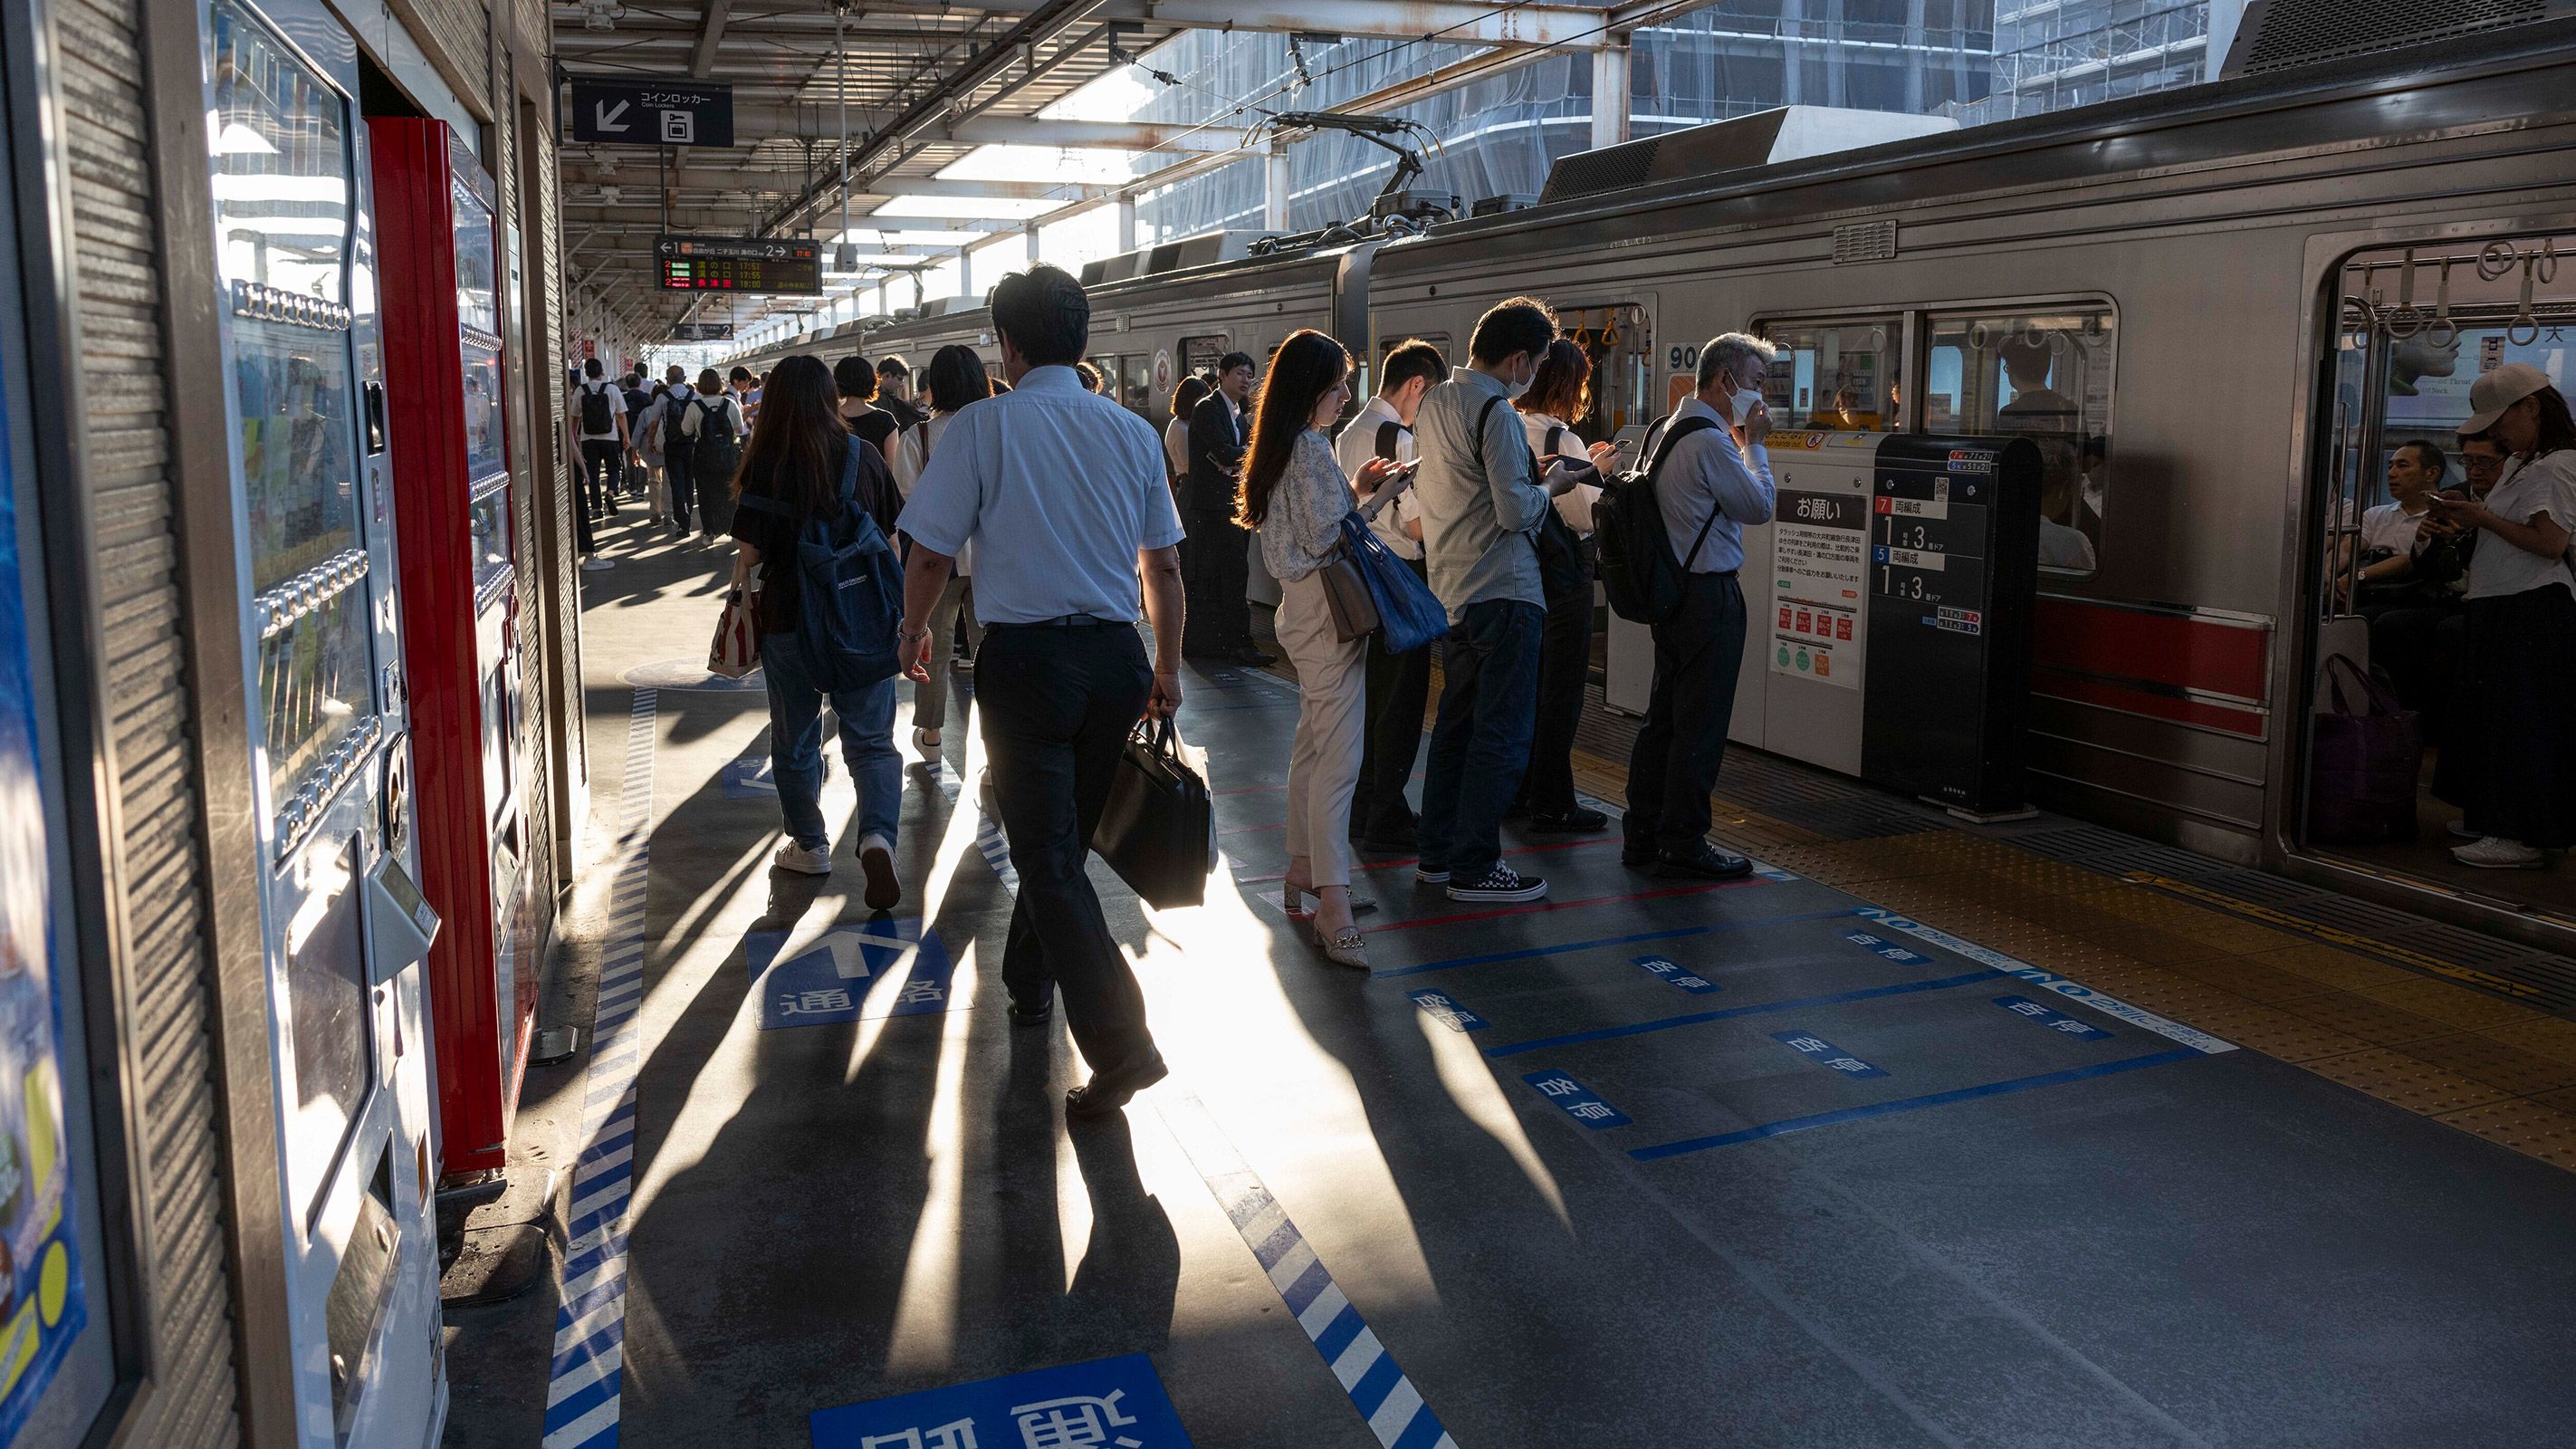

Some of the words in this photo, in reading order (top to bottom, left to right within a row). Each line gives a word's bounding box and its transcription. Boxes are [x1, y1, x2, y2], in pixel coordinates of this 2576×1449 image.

[641, 92, 711, 104] コインロッカー
[766, 245, 774, 257] 2
[723, 325, 731, 336] 2
[1671, 347, 1704, 369] 90
[1796, 497, 1841, 521] お願い
[1880, 499, 1887, 512] 7
[1895, 500, 1921, 514] 両編成
[1878, 548, 1885, 561] 5
[1892, 550, 1919, 565] 両編成
[1847, 934, 1918, 960] 各停
[1642, 960, 1710, 988] 各停
[1413, 994, 1478, 1030] 各停
[2008, 1002, 2095, 1032] 各停
[1787, 1037, 1871, 1071] 各停
[1536, 1078, 1615, 1119] 各停
